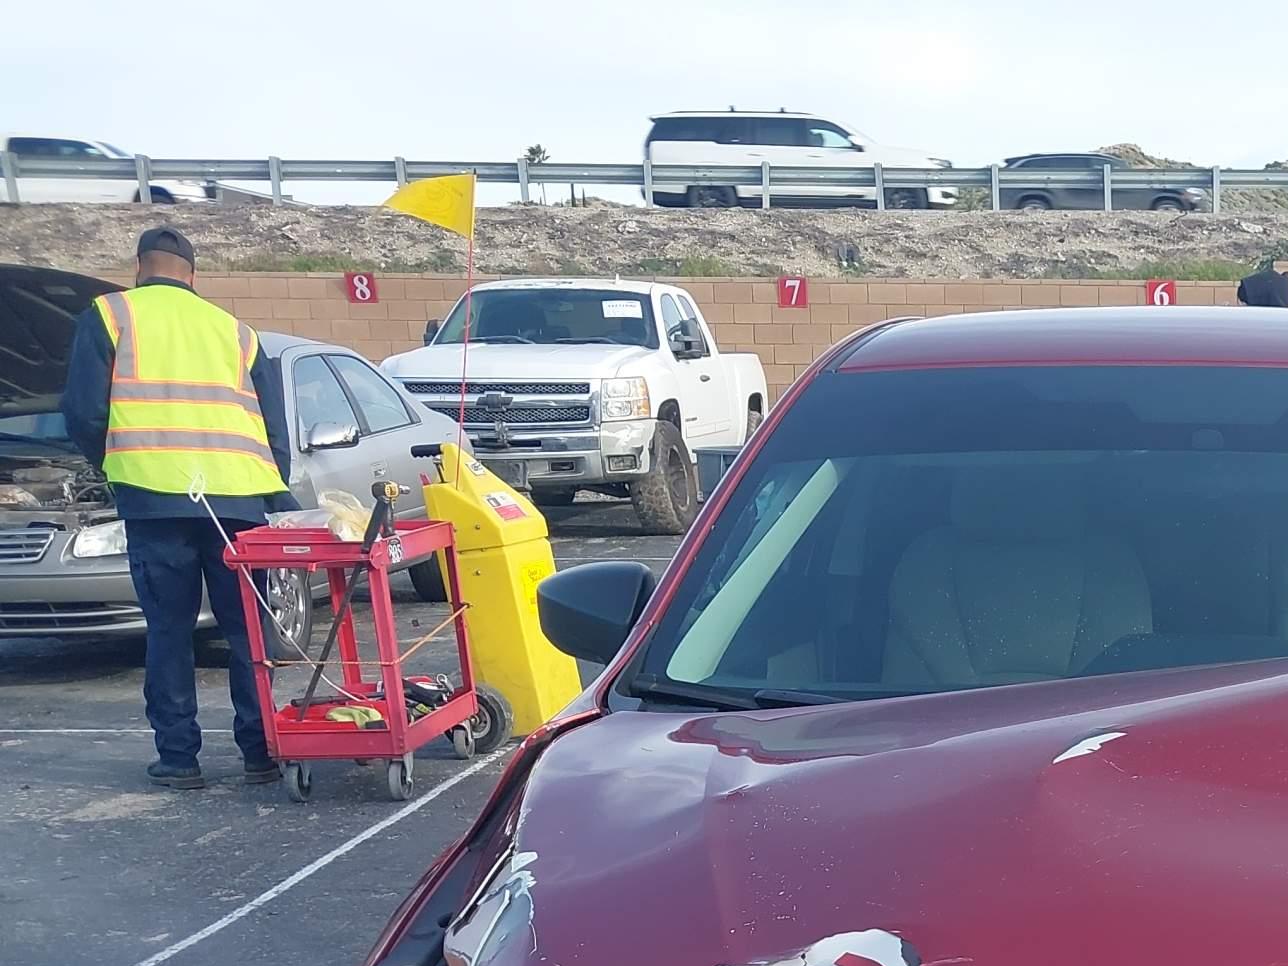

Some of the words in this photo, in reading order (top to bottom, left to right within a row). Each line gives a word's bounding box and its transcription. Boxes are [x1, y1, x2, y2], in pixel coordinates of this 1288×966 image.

[352, 274, 371, 301] 8
[784, 280, 801, 305] 7
[1153, 283, 1170, 306] 6
